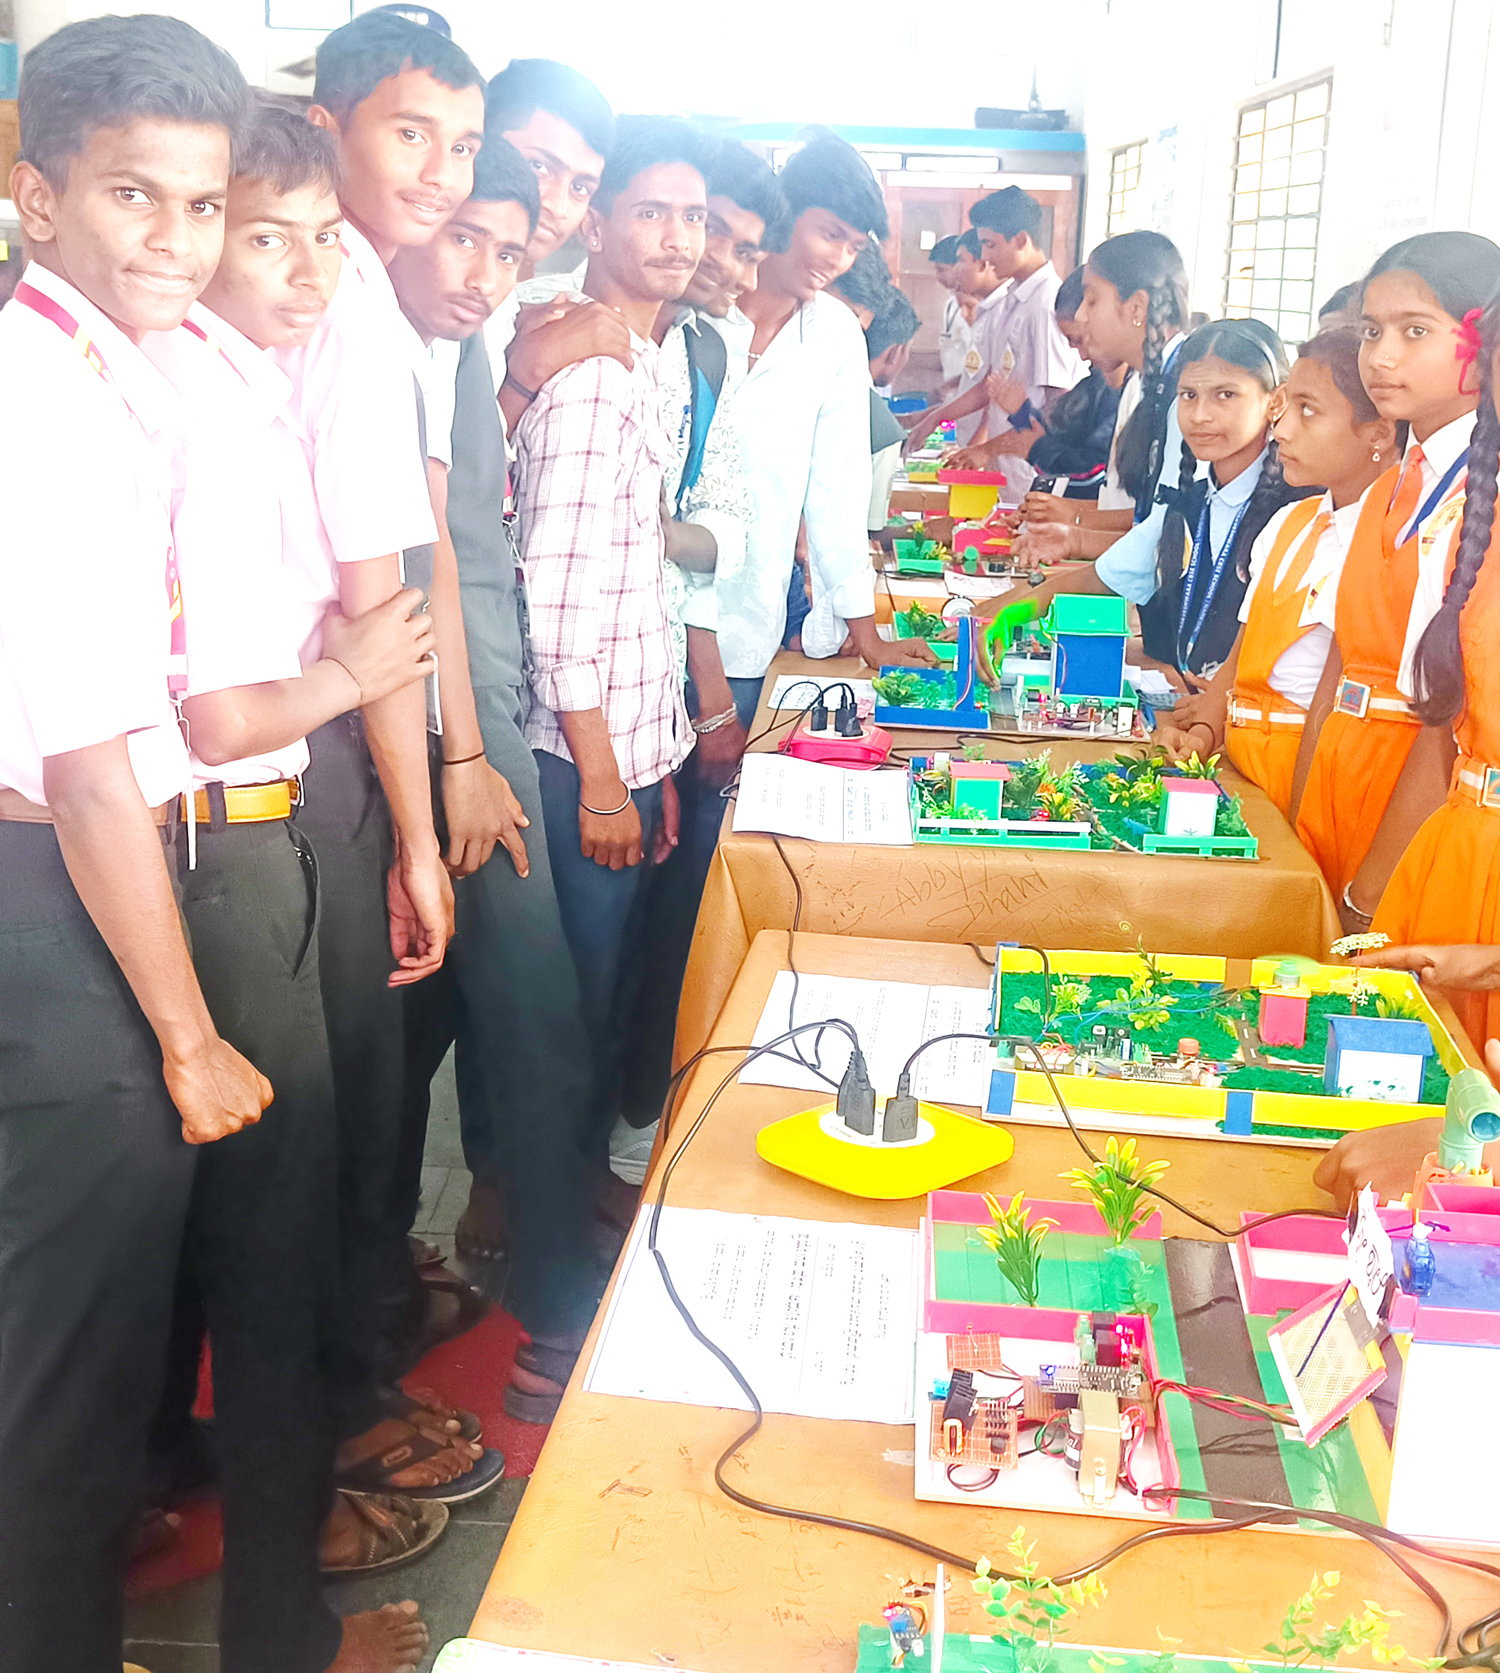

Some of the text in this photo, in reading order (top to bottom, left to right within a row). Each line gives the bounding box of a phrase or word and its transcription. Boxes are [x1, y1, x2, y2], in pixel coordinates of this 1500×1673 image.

[1190, 542, 1200, 567] SCHOOL
[1186, 567, 1196, 583] CBSE
[1214, 557, 1225, 573] CBSE
[1205, 572, 1220, 599] SCHOOL
